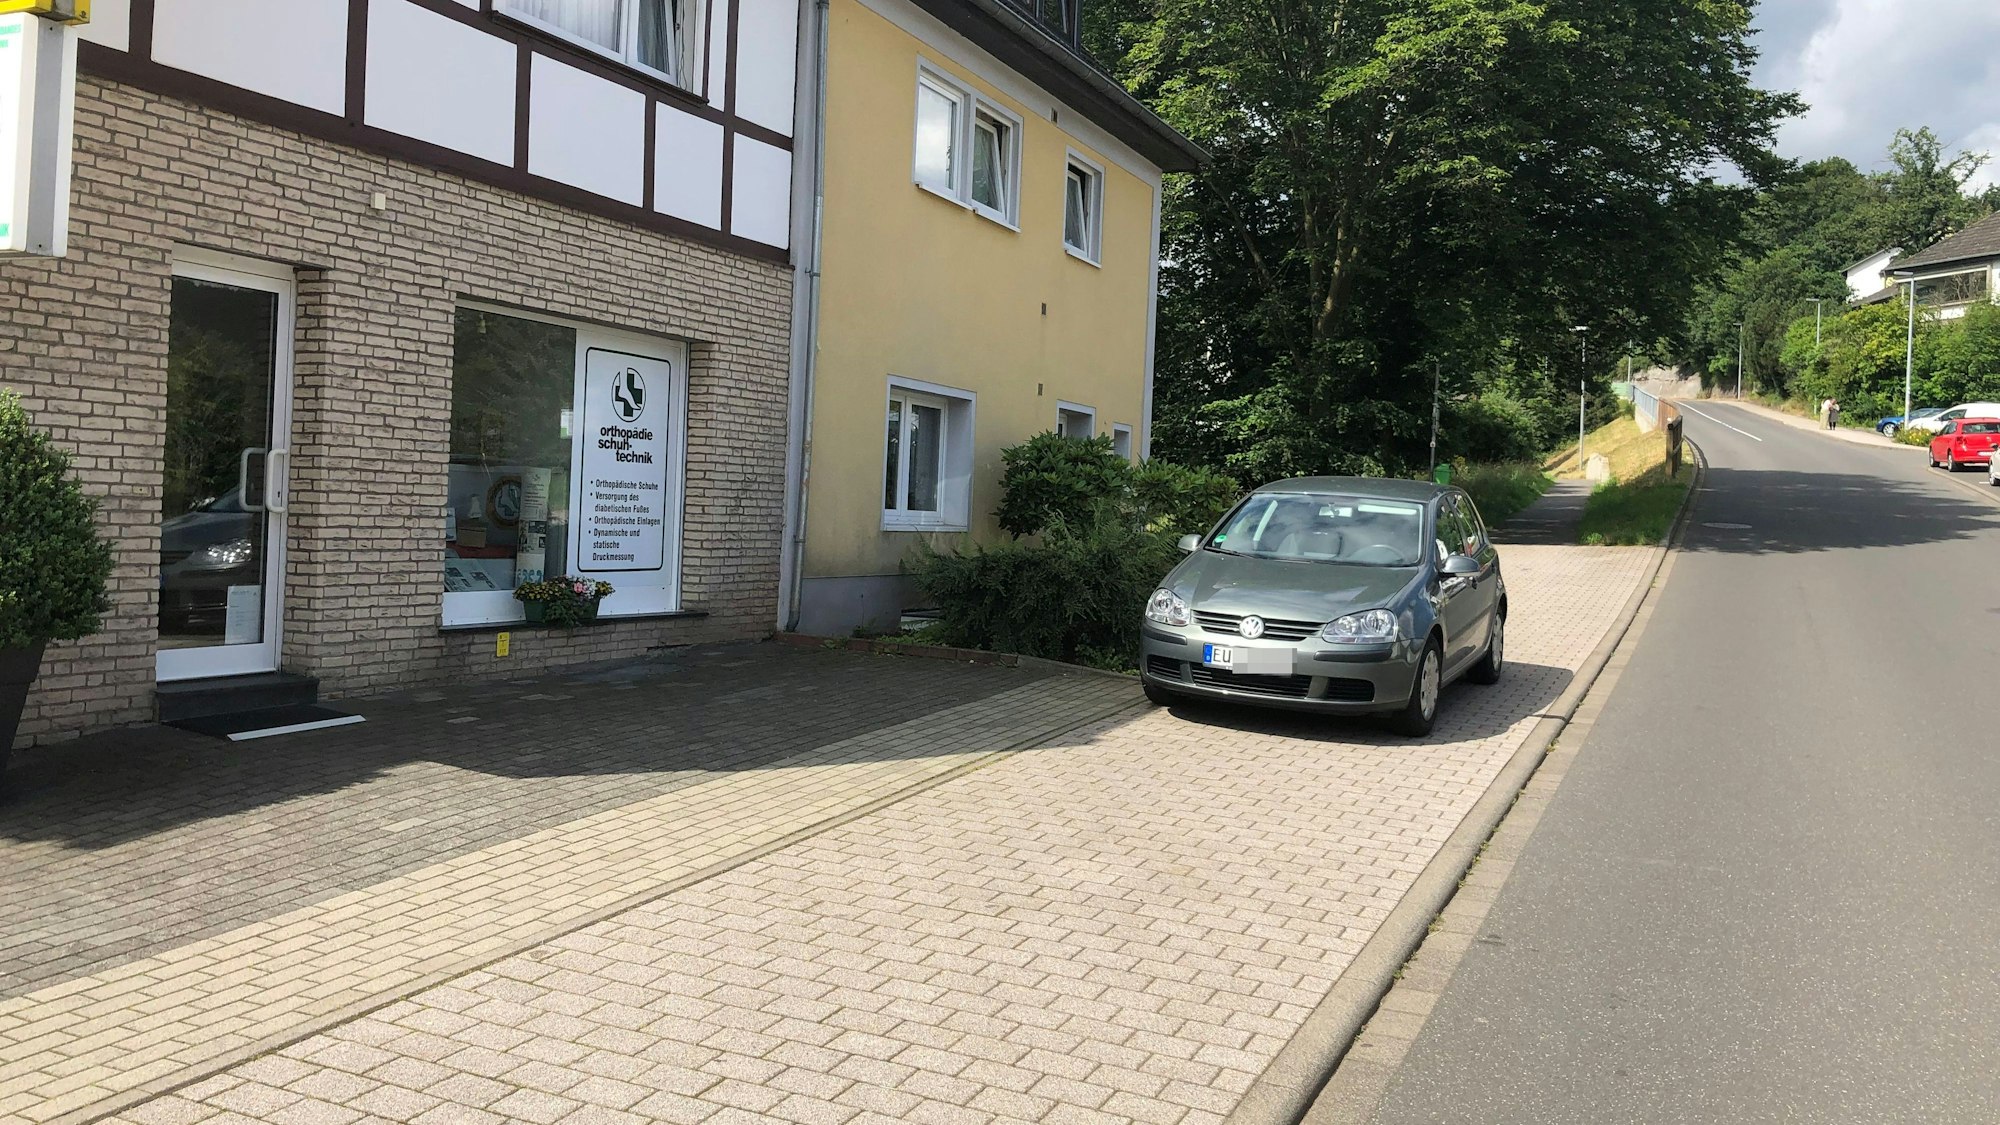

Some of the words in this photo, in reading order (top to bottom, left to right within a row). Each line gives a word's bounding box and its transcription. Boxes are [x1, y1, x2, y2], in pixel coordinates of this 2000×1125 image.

[600, 425, 653, 441] orthopädie
[616, 450, 653, 464] technik
[595, 479, 638, 491] Orthopädische
[638, 481, 659, 490] Schuhe
[595, 491, 628, 502] Versorgung
[629, 493, 640, 501] des
[594, 503, 632, 513] diabetischen
[594, 515, 636, 526] Orthopädische
[637, 516, 661, 527] Einlagen
[593, 527, 628, 538] Dynamische
[629, 529, 641, 537] und
[592, 540, 620, 549] statische
[592, 552, 635, 562] Druckmessung
[1213, 648, 1232, 663] EU
